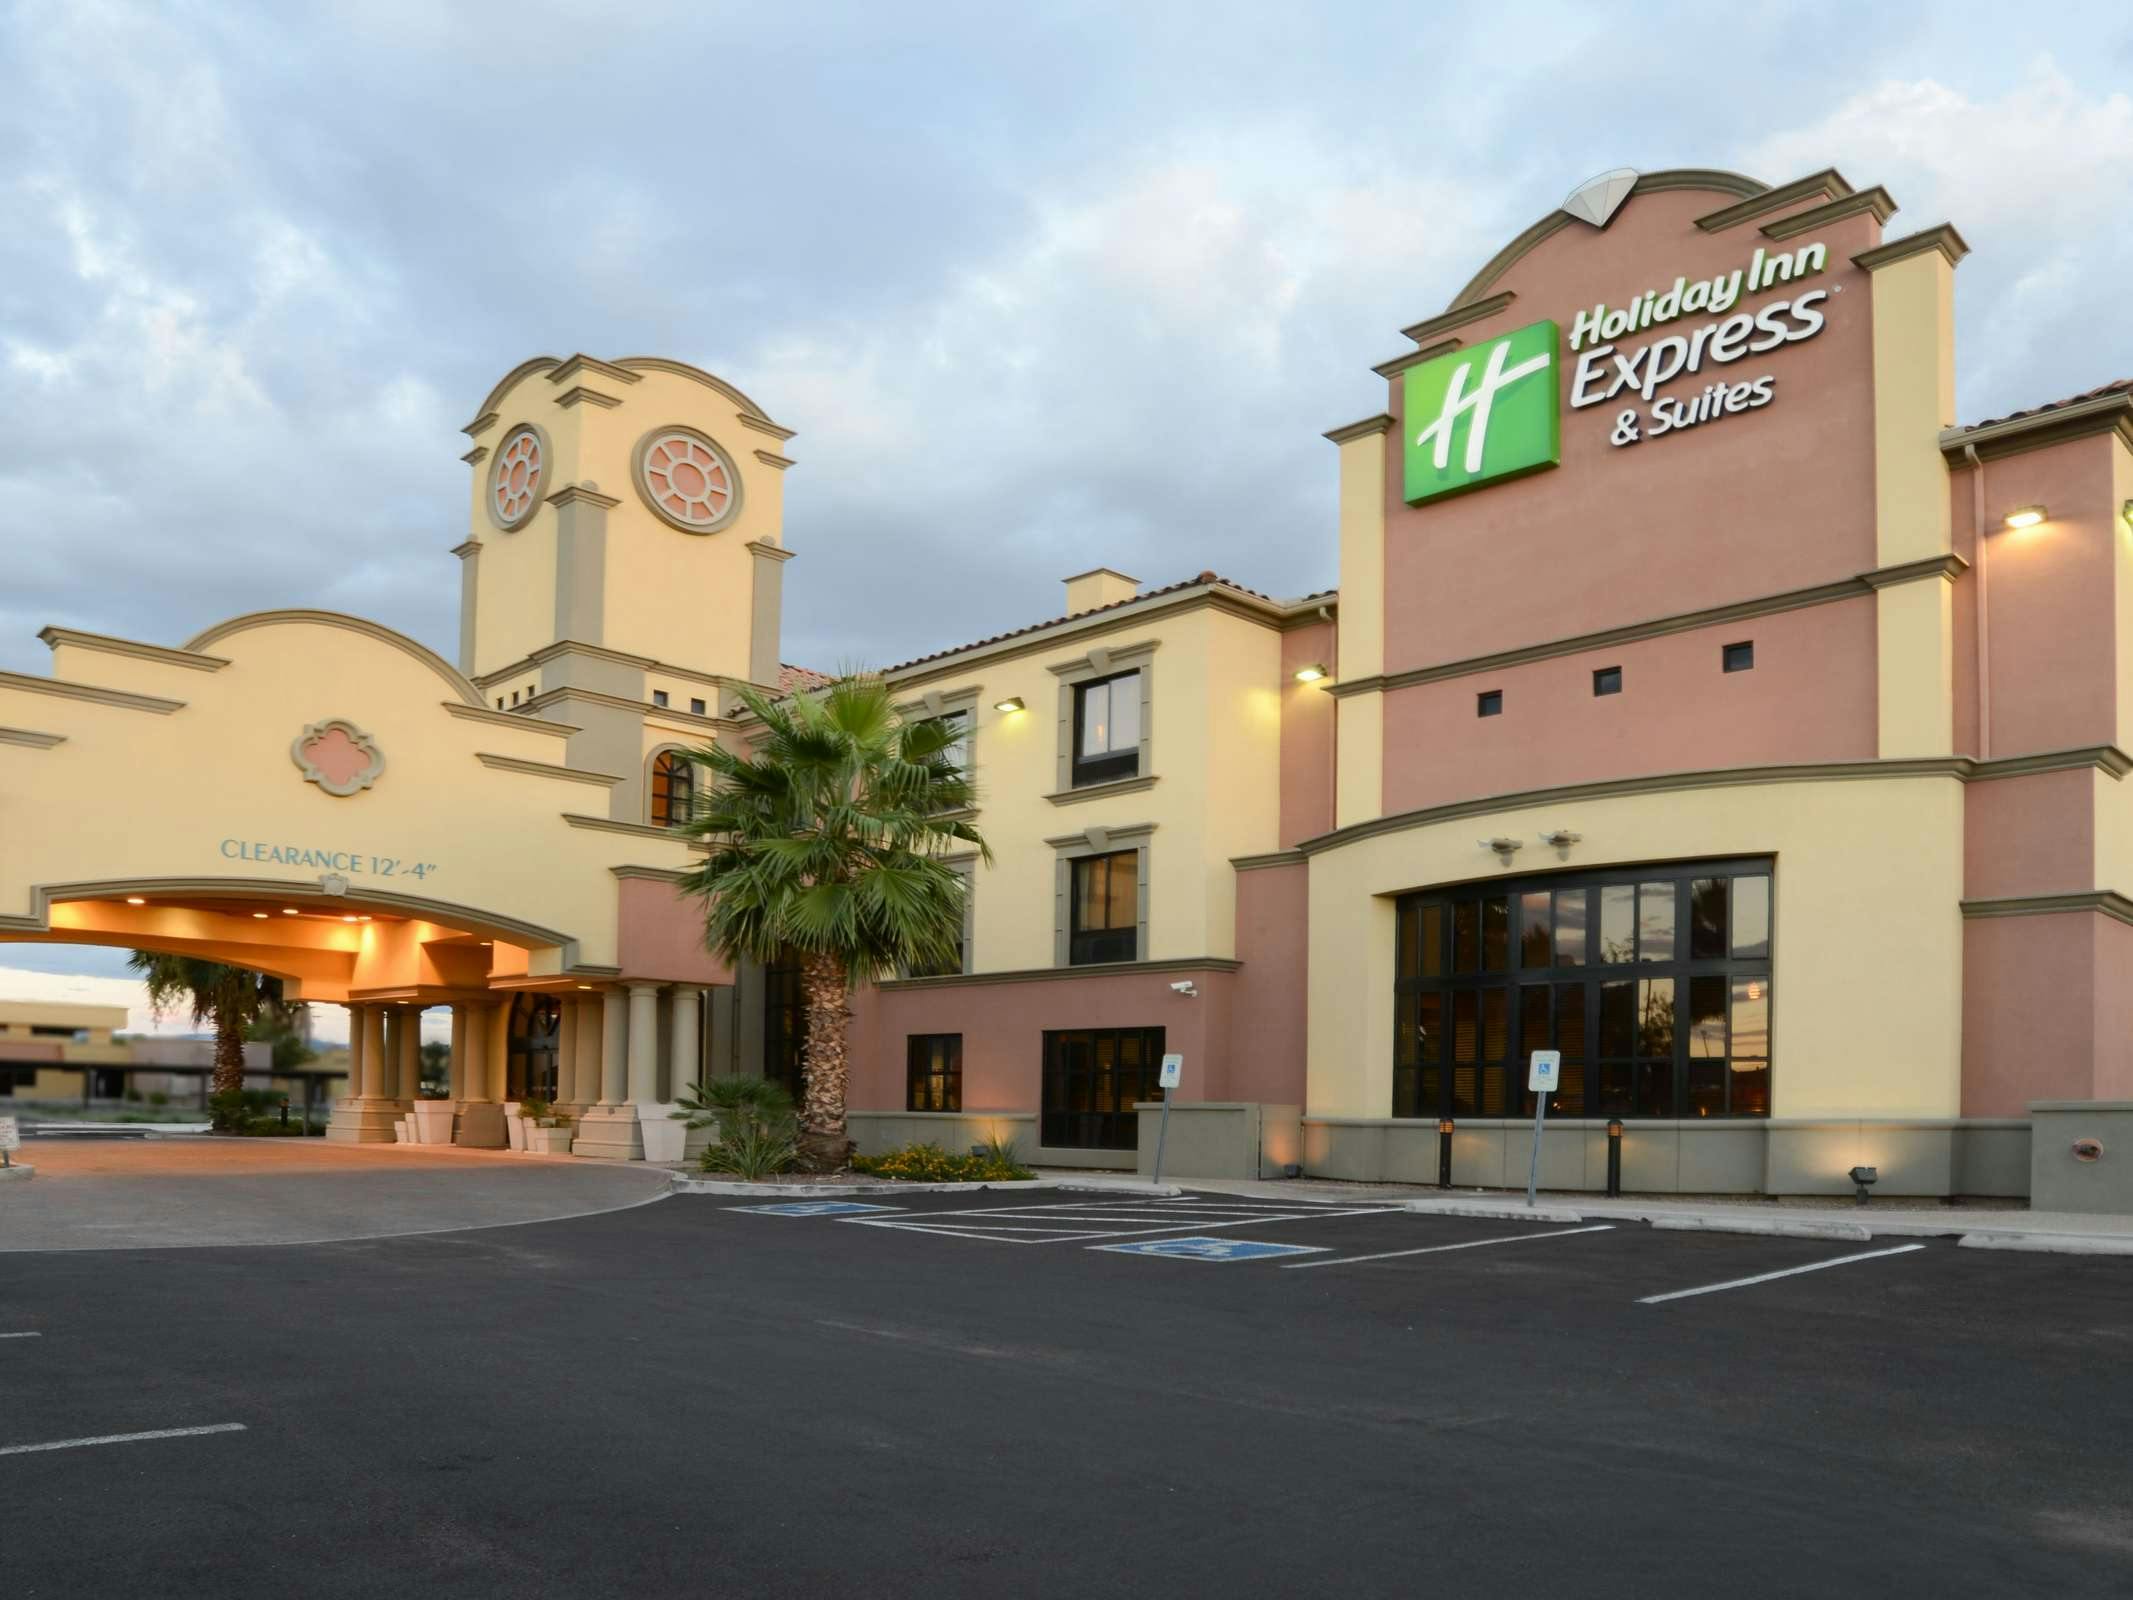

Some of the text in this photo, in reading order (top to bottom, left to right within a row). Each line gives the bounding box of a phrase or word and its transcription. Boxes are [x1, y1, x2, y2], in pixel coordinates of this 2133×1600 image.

[1569, 242, 1827, 351] Holiday Inn
[1570, 289, 1828, 408] Express
[1610, 375, 1776, 446] & Suites
[220, 838, 363, 873] CLEARANCE
